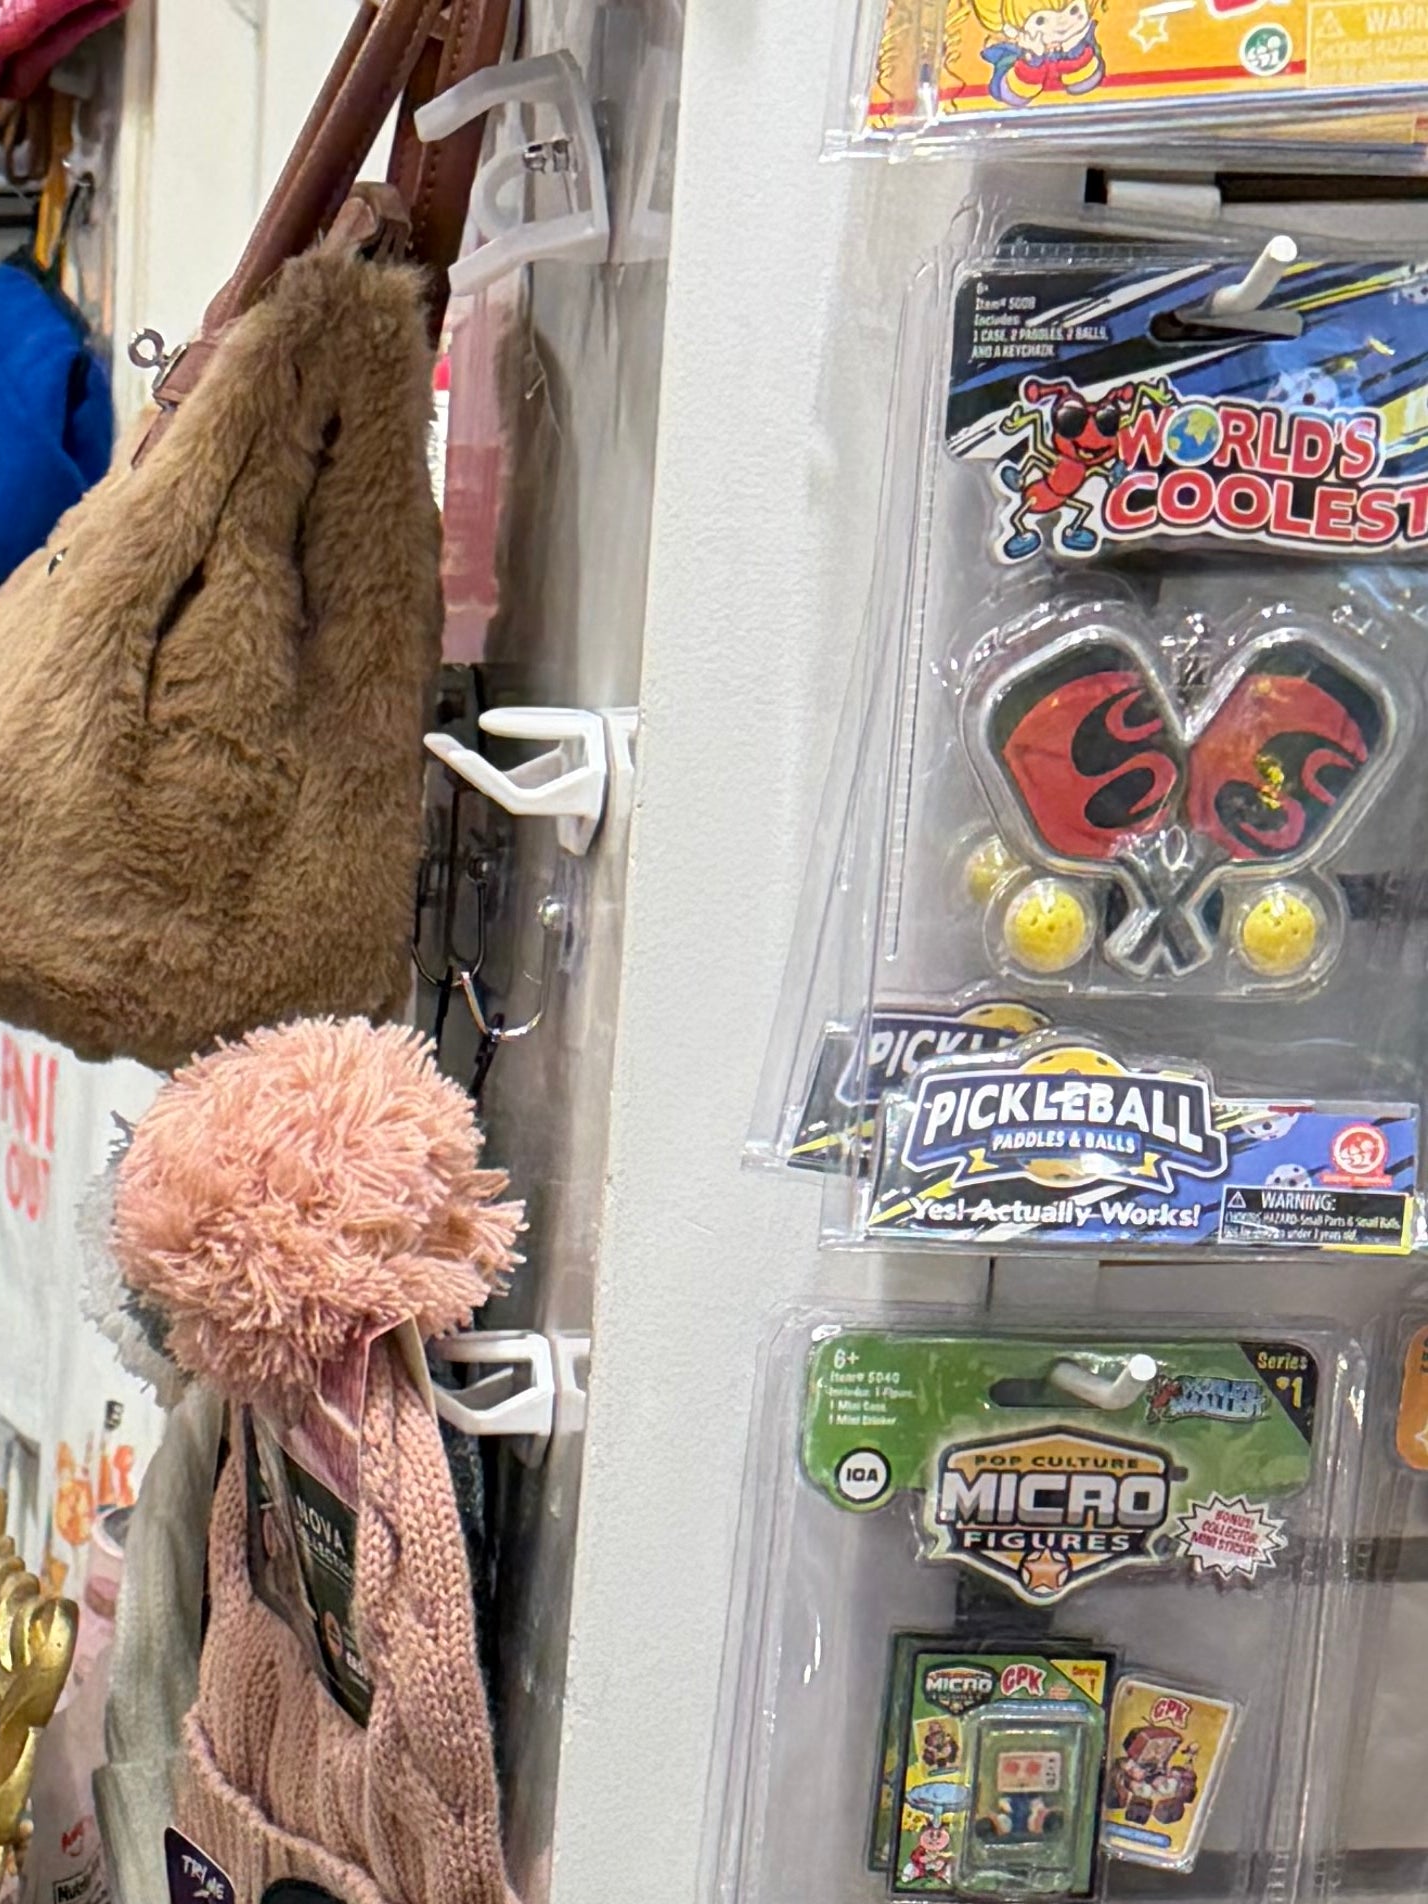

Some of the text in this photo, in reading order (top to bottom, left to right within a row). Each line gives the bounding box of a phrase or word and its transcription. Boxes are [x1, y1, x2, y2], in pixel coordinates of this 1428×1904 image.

[1118, 403, 1375, 478] WORLD'S
[1106, 473, 1428, 541] COOLEST
[924, 1082, 1203, 1152] PICKLEBALL
[993, 1131, 1135, 1153] PADDLES & BALLS
[1262, 1192, 1336, 1211] WARNING:
[912, 1198, 1200, 1230] Yes! Actually Works!
[834, 1348, 1308, 1371] 6+ Series
[974, 1454, 1140, 1470] POP CULTURE
[941, 1473, 1167, 1526] MICRO
[1215, 1509, 1255, 1528] BONUS!
[964, 1531, 1131, 1552] FIGURES
[1191, 1532, 1216, 1548] MINI
[1201, 1520, 1259, 1543] COLLECTOR
[926, 1676, 993, 1694] MICRO
[1001, 1665, 1044, 1695] GPK
[1154, 1700, 1190, 1726] GPK
[181, 1855, 208, 1885] TRY
